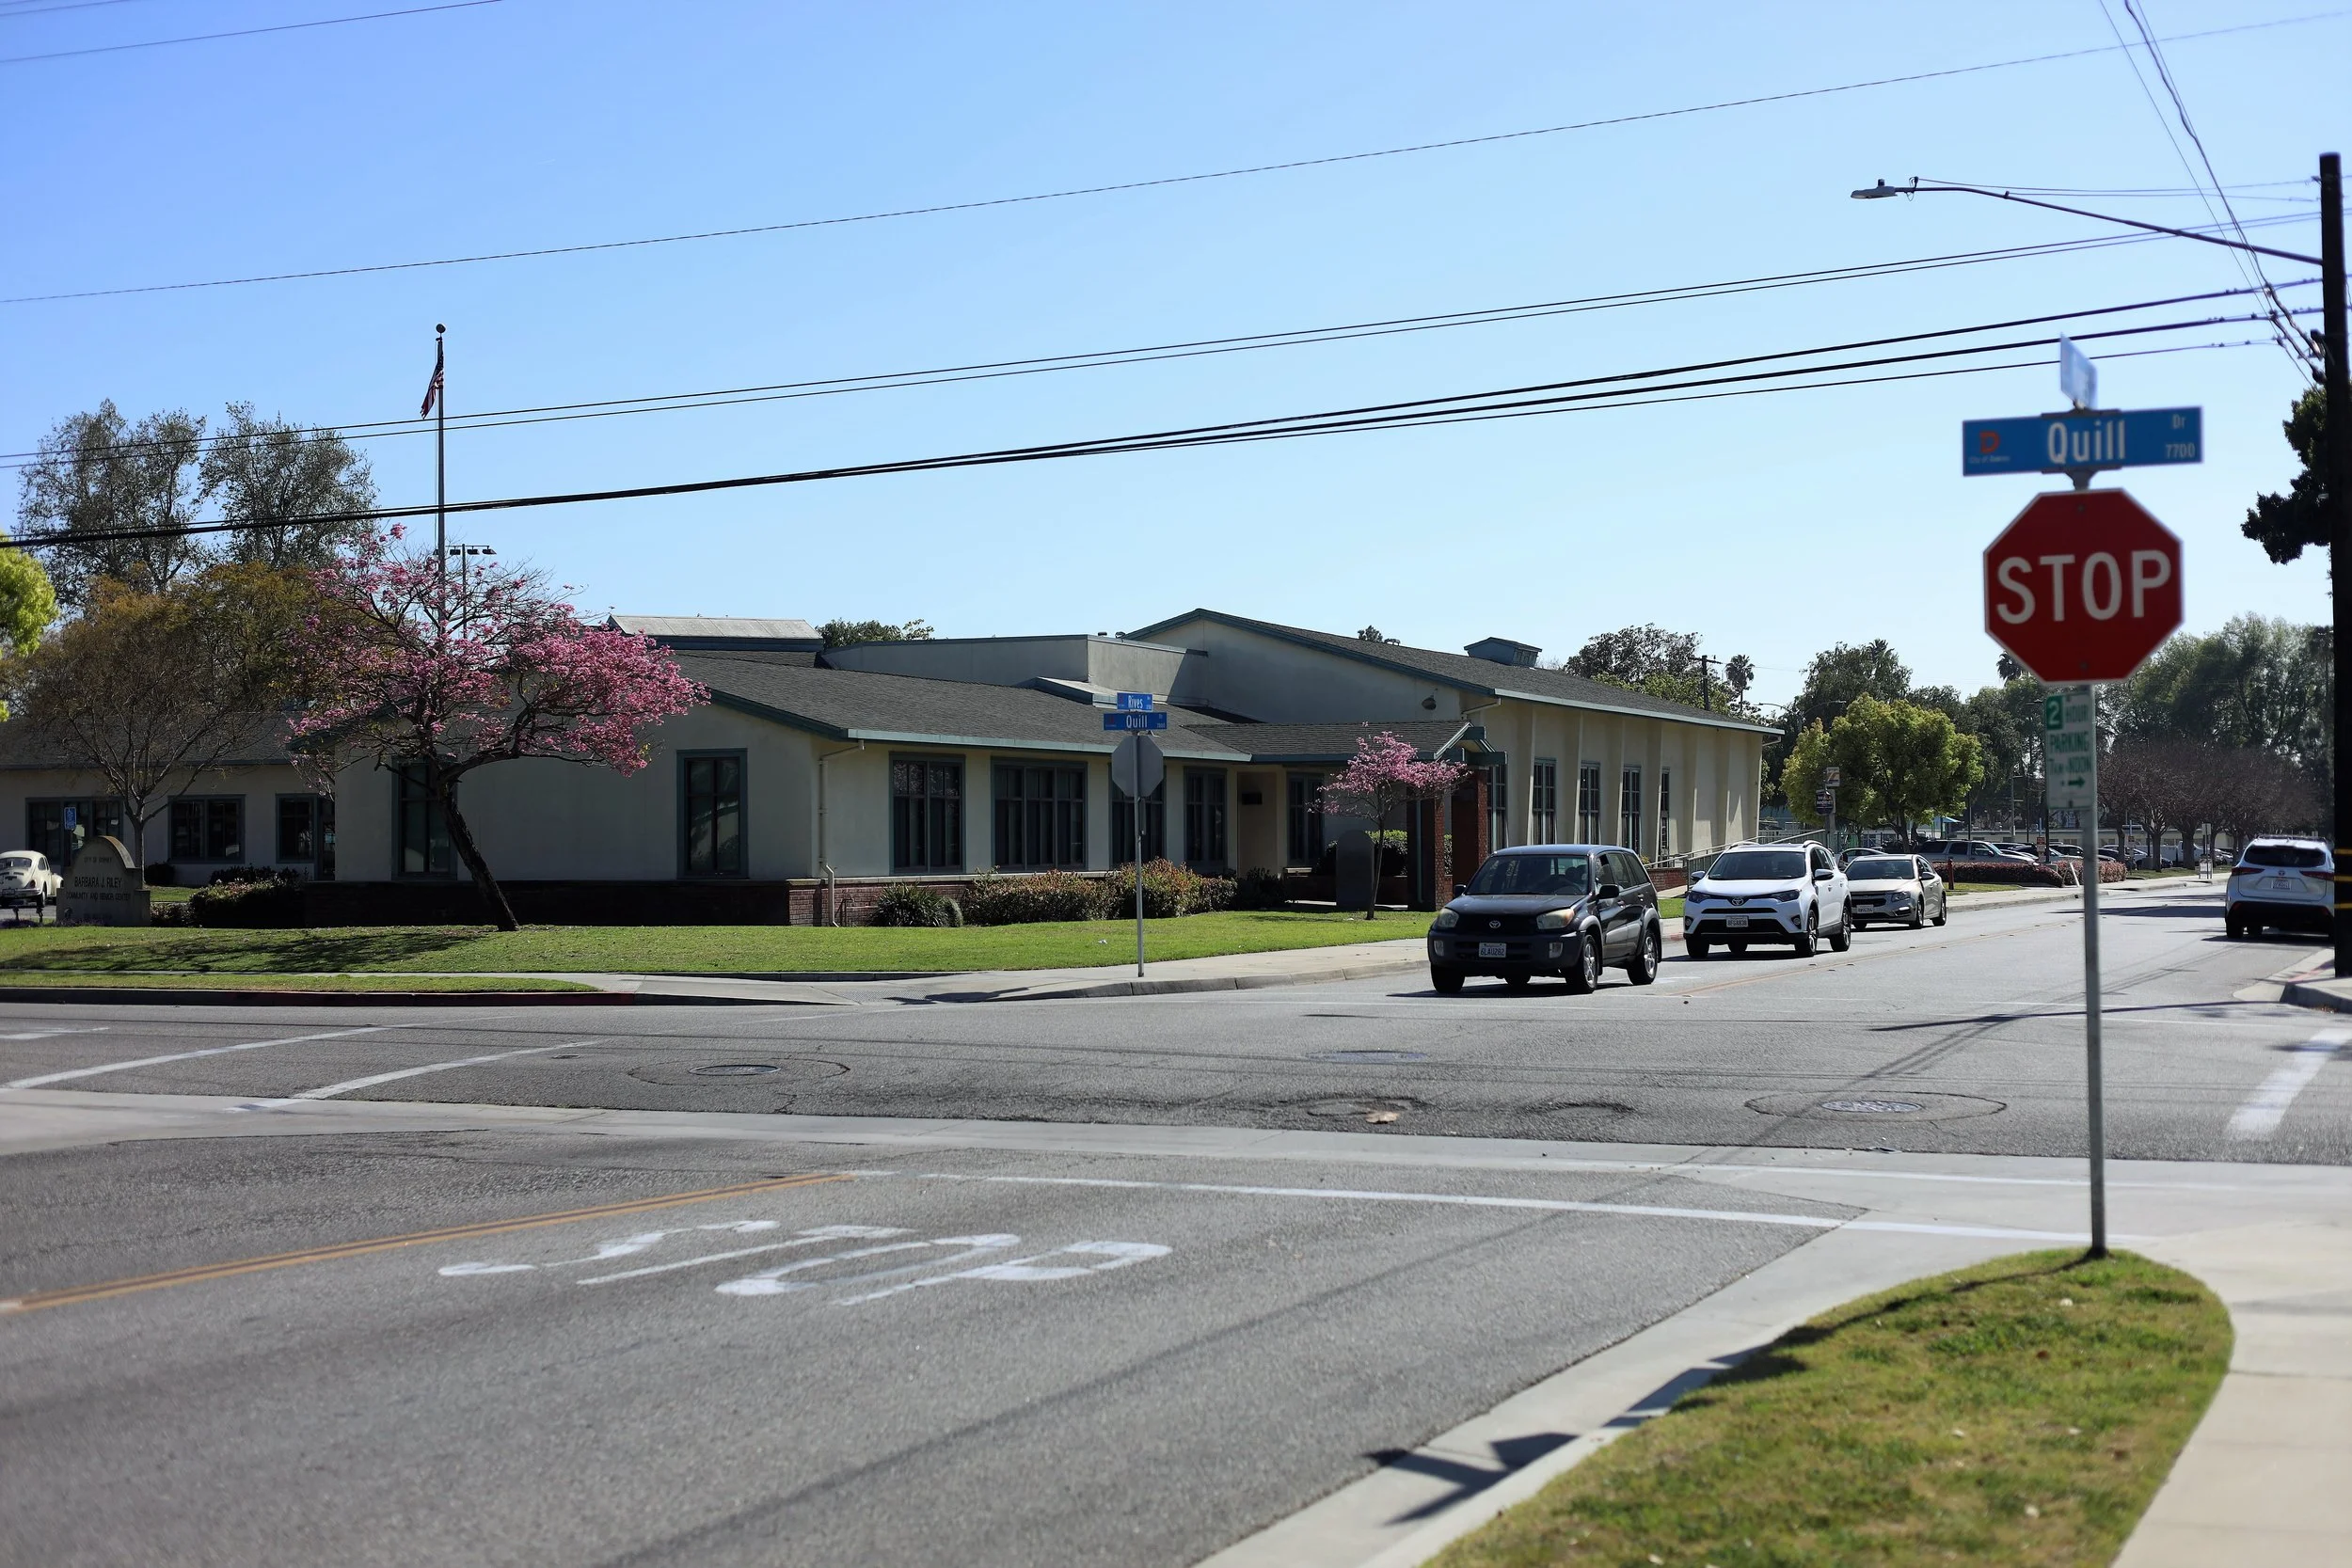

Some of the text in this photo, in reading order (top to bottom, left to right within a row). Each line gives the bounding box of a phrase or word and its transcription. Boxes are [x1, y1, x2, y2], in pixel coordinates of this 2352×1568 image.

[2172, 414, 2185, 429] Dr
[2047, 420, 2126, 464] Quill
[2165, 443, 2195, 459] 7700
[1996, 549, 2171, 625] STOP
[1126, 715, 1148, 729] Quill
[2048, 700, 2089, 725] 2 HOUR
[2050, 731, 2090, 753] PARKING
[74, 876, 99, 888] BARBARA
[107, 877, 122, 888] RILEY
[66, 891, 89, 900] COMMUNITY
[100, 893, 114, 901] SENIOR
[115, 893, 131, 901] CENTER
[437, 1219, 1172, 1306] STOP
